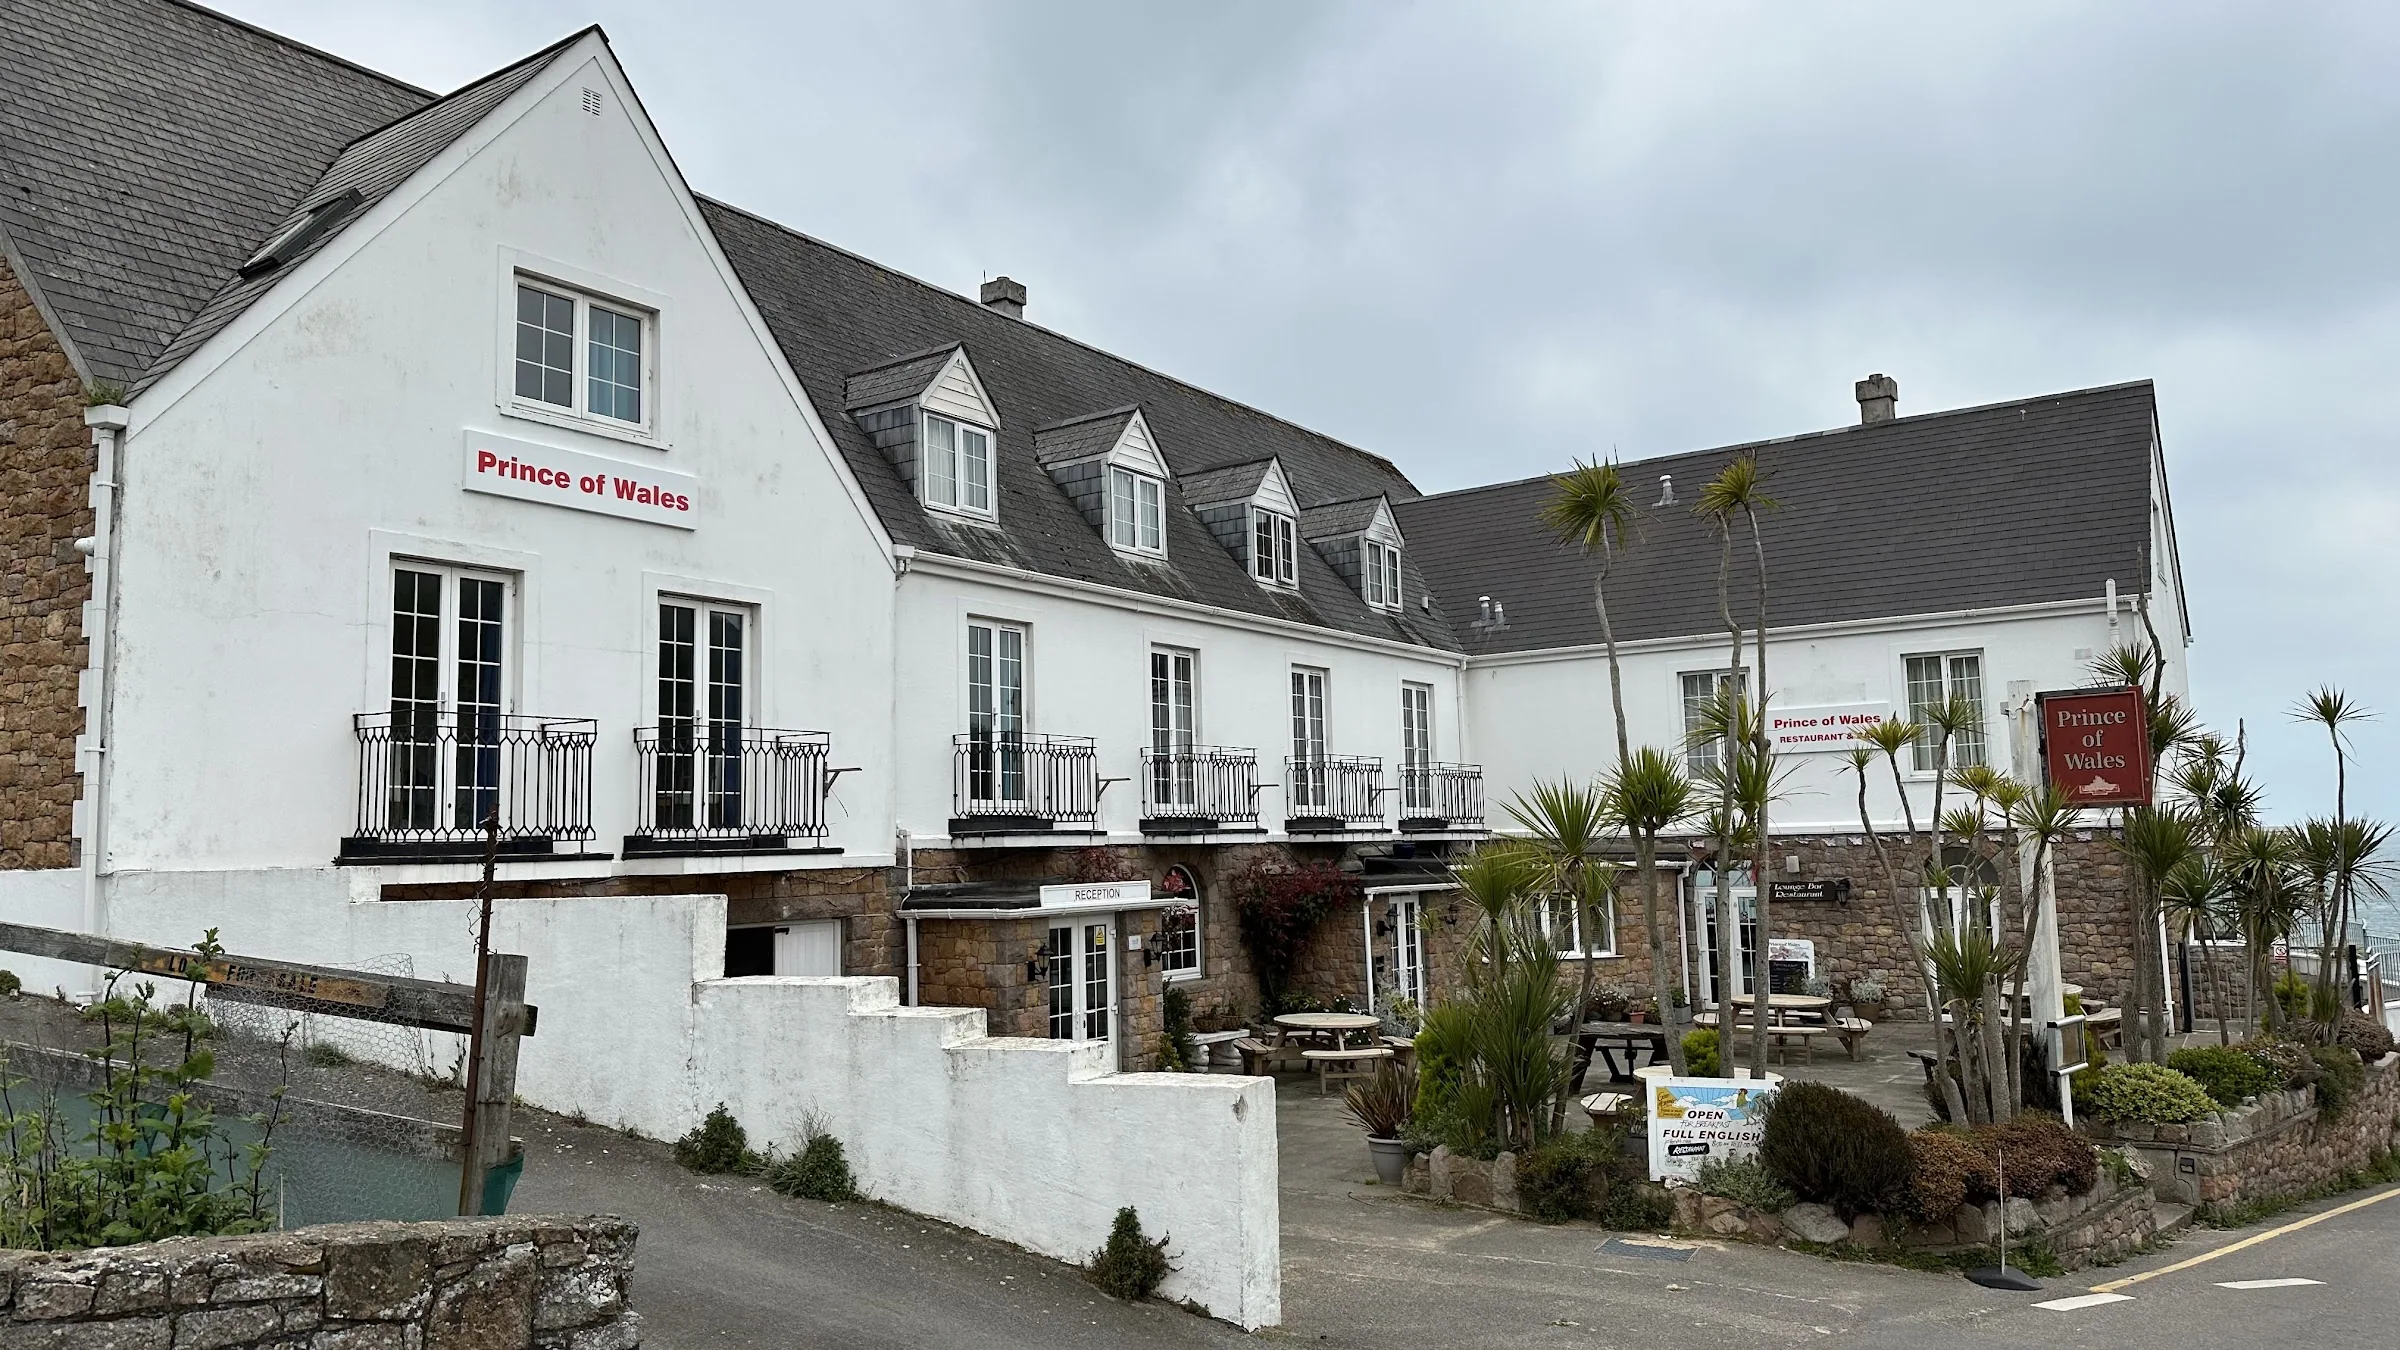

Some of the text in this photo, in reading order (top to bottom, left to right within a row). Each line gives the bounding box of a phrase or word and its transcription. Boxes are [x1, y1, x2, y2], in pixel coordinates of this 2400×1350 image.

[478, 450, 690, 512] Prince of Wales
[1774, 714, 1881, 729] Prince of Wales
[2057, 708, 2126, 727] Prince
[1780, 733, 1843, 744] RESTAURANT
[1846, 732, 1854, 741] &
[2082, 729, 2104, 747] of
[2064, 751, 2126, 770] Wales
[1774, 882, 1824, 892] Lounge Bar
[1075, 888, 1120, 901] RECEPTION
[1775, 890, 1825, 898] Restaurant
[1687, 1110, 1724, 1120] OPEN
[1695, 1120, 1732, 1128] BREAKFAST
[1663, 1129, 1761, 1141] FULL ENGLISH
